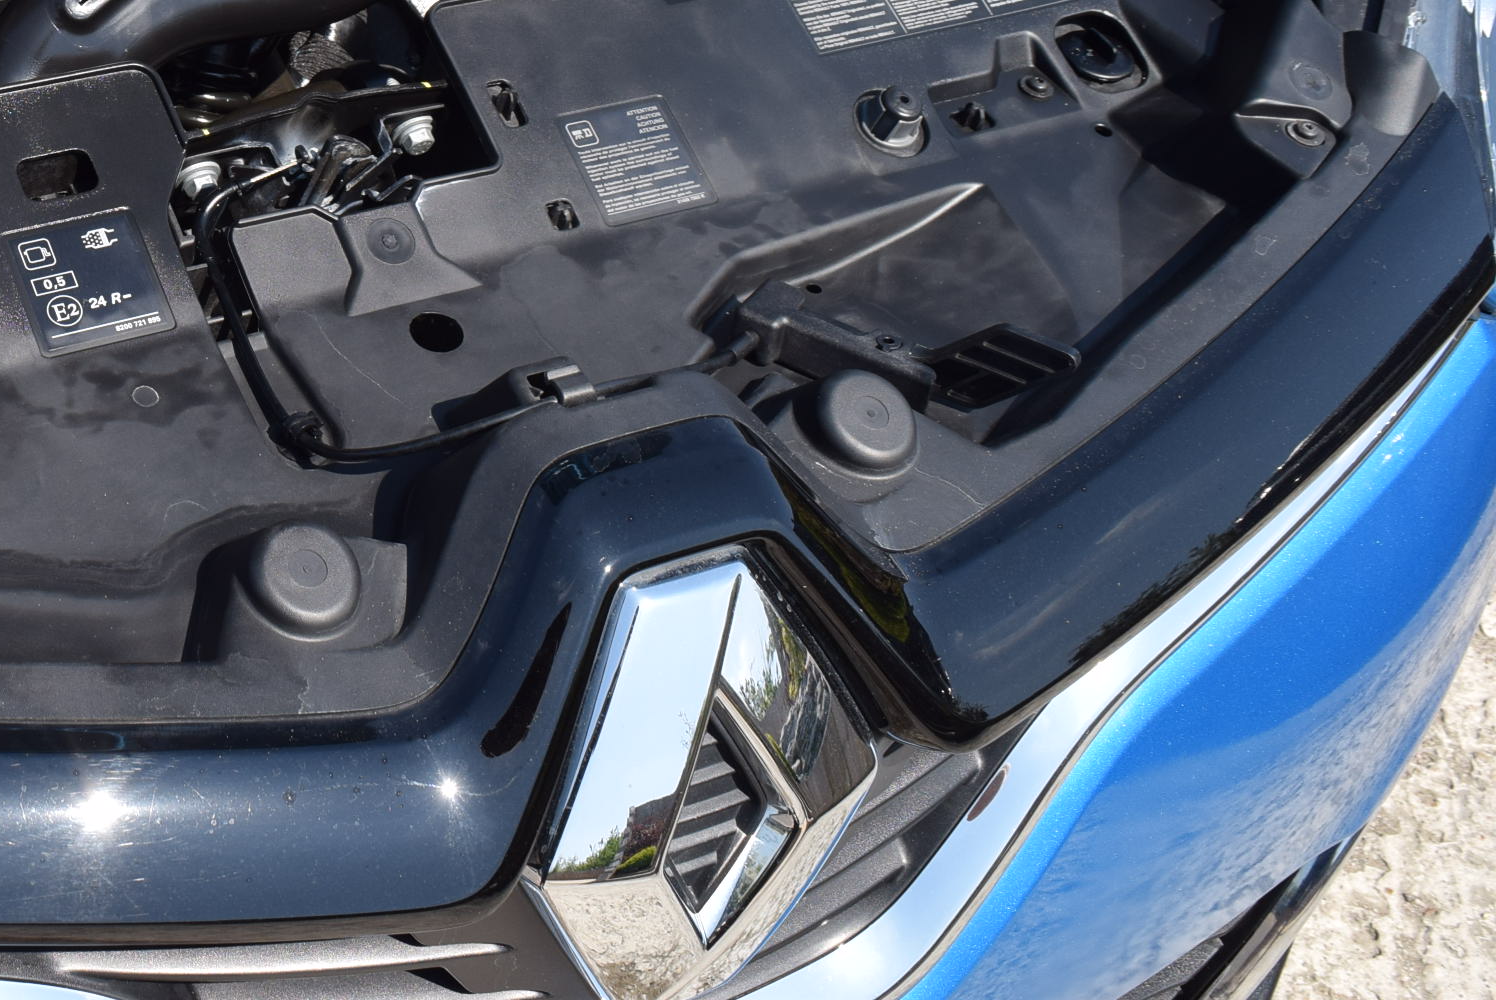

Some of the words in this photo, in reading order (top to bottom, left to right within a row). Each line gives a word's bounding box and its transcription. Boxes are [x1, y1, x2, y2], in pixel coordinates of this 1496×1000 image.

[42, 276, 67, 291] 0,5
[88, 295, 107, 310] 24
[50, 303, 80, 322] E2
[115, 322, 133, 332] 8200
[133, 319, 147, 328] 721
